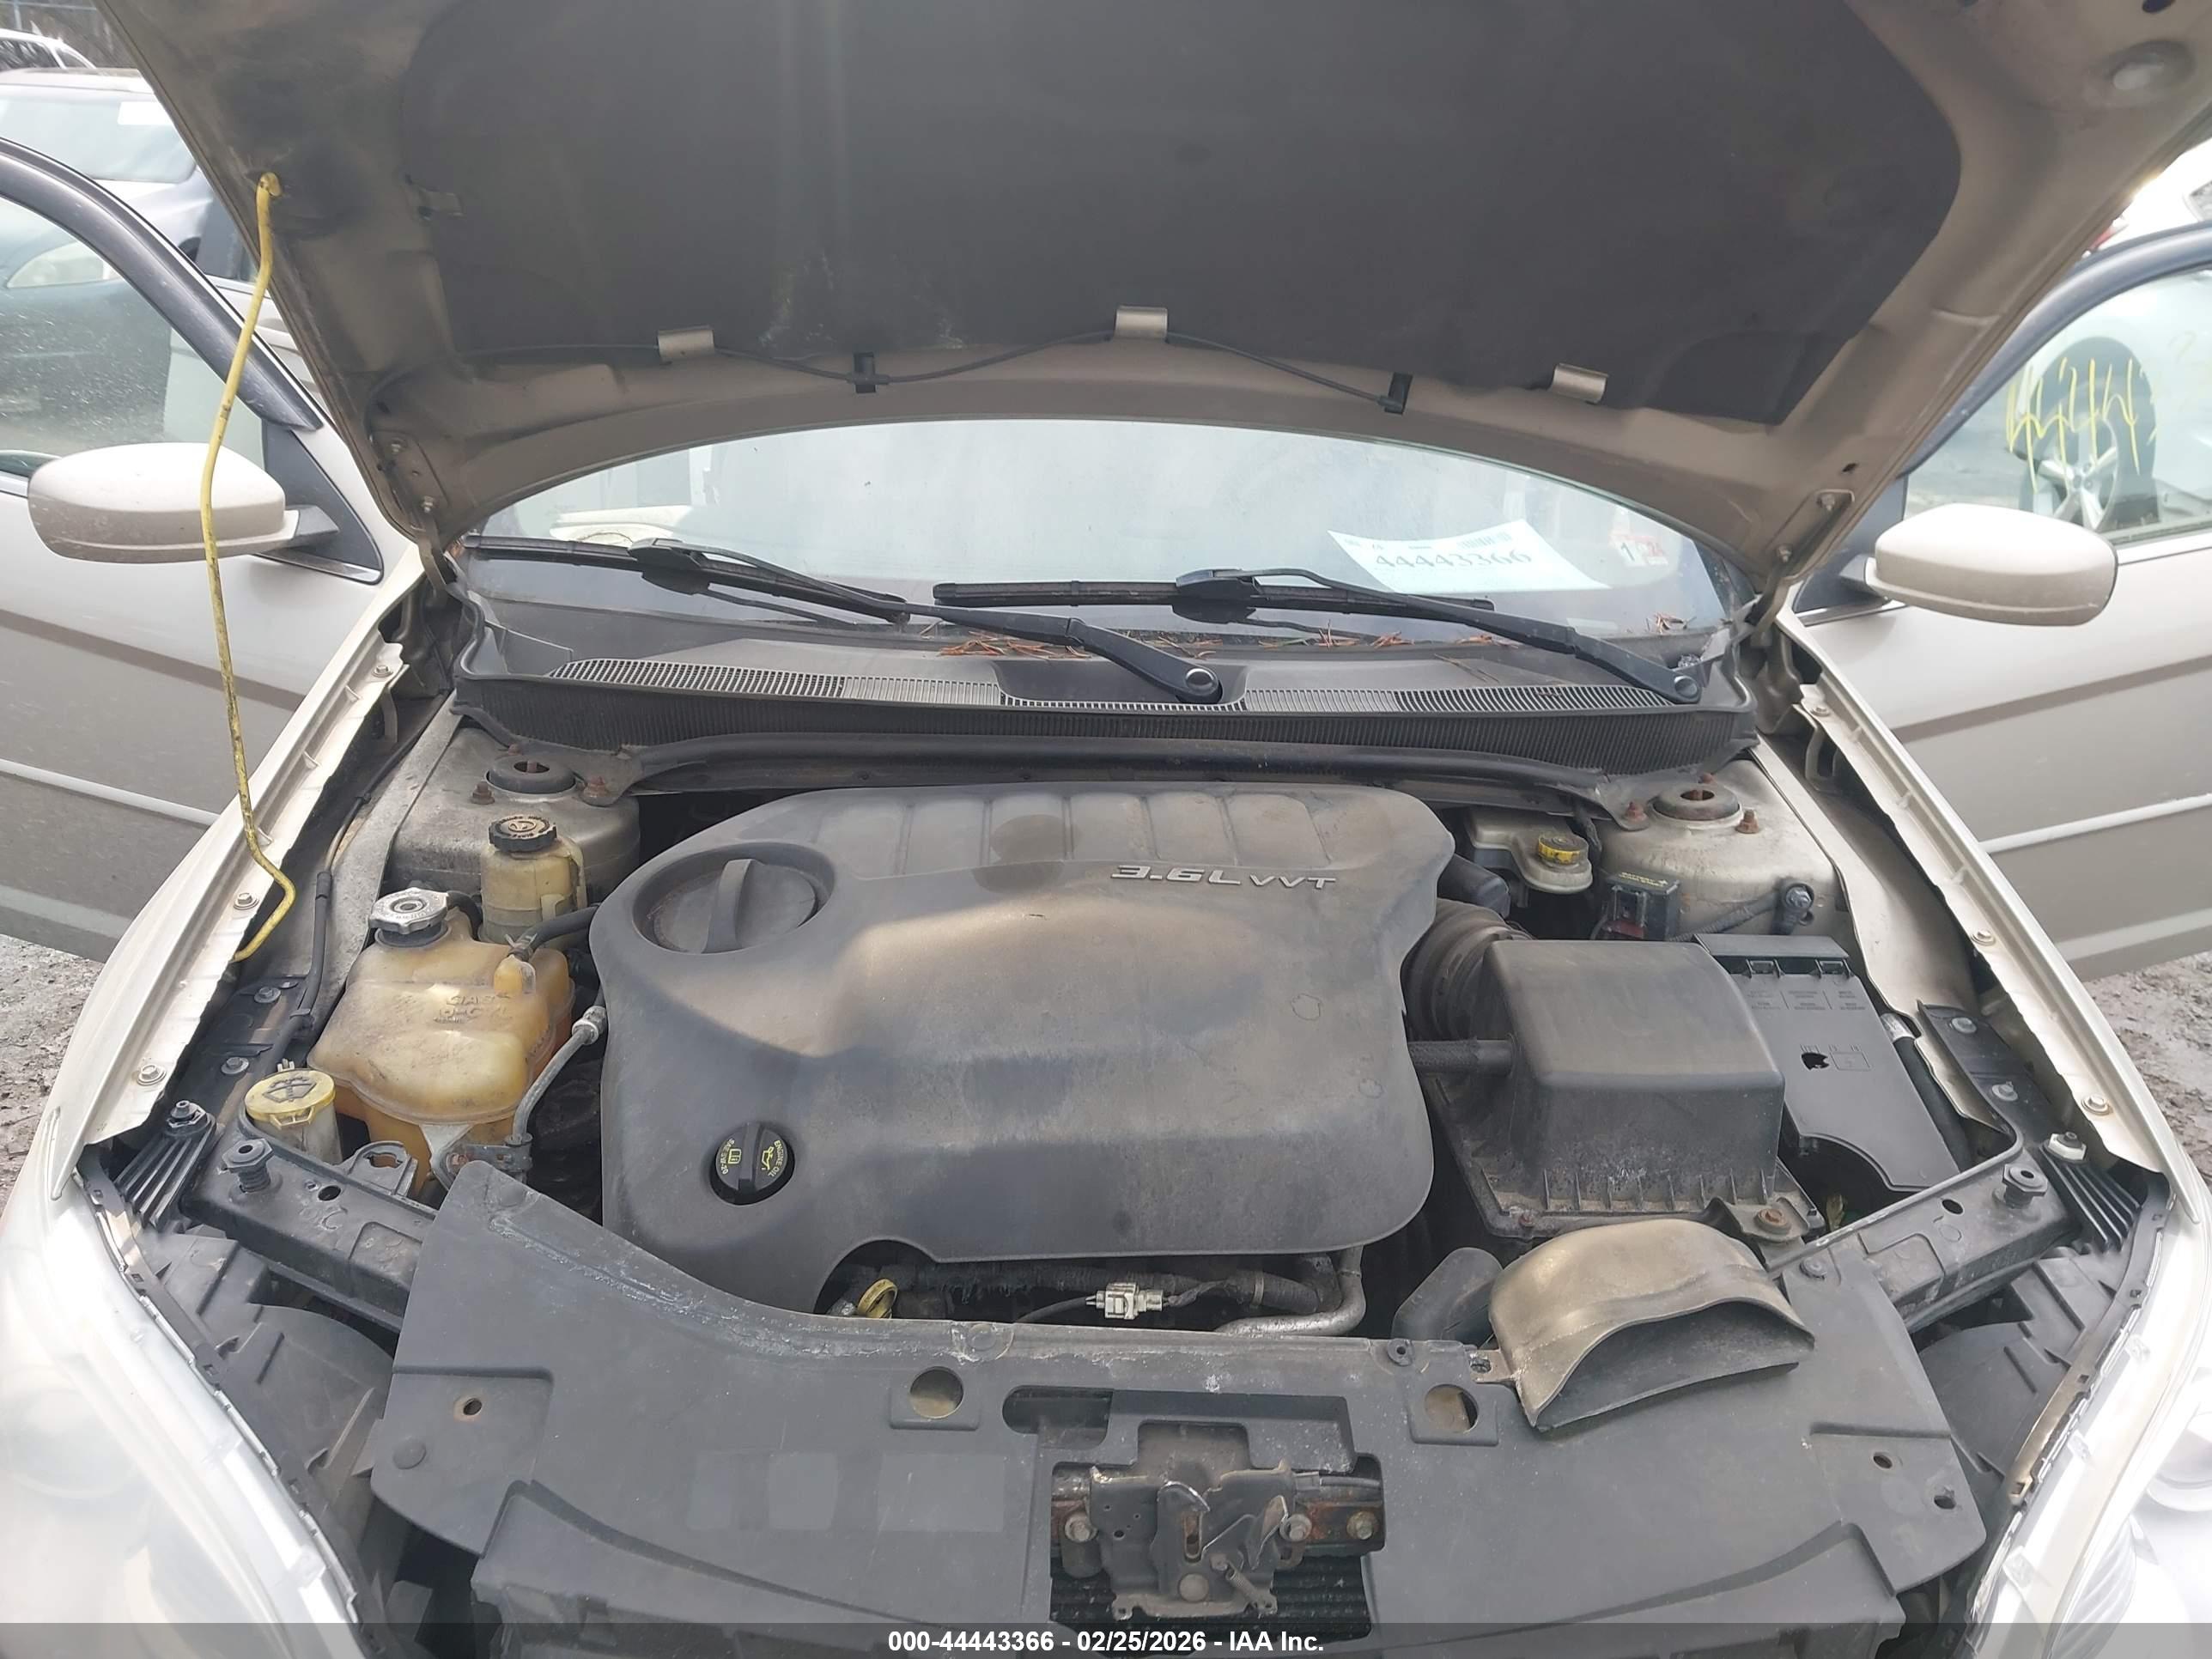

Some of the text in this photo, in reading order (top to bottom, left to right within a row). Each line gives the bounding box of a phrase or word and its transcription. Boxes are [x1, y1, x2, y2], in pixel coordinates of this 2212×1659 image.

[1110, 865, 1336, 890] 3.6L VVT
[767, 1139, 784, 1177] ENGINE OIL
